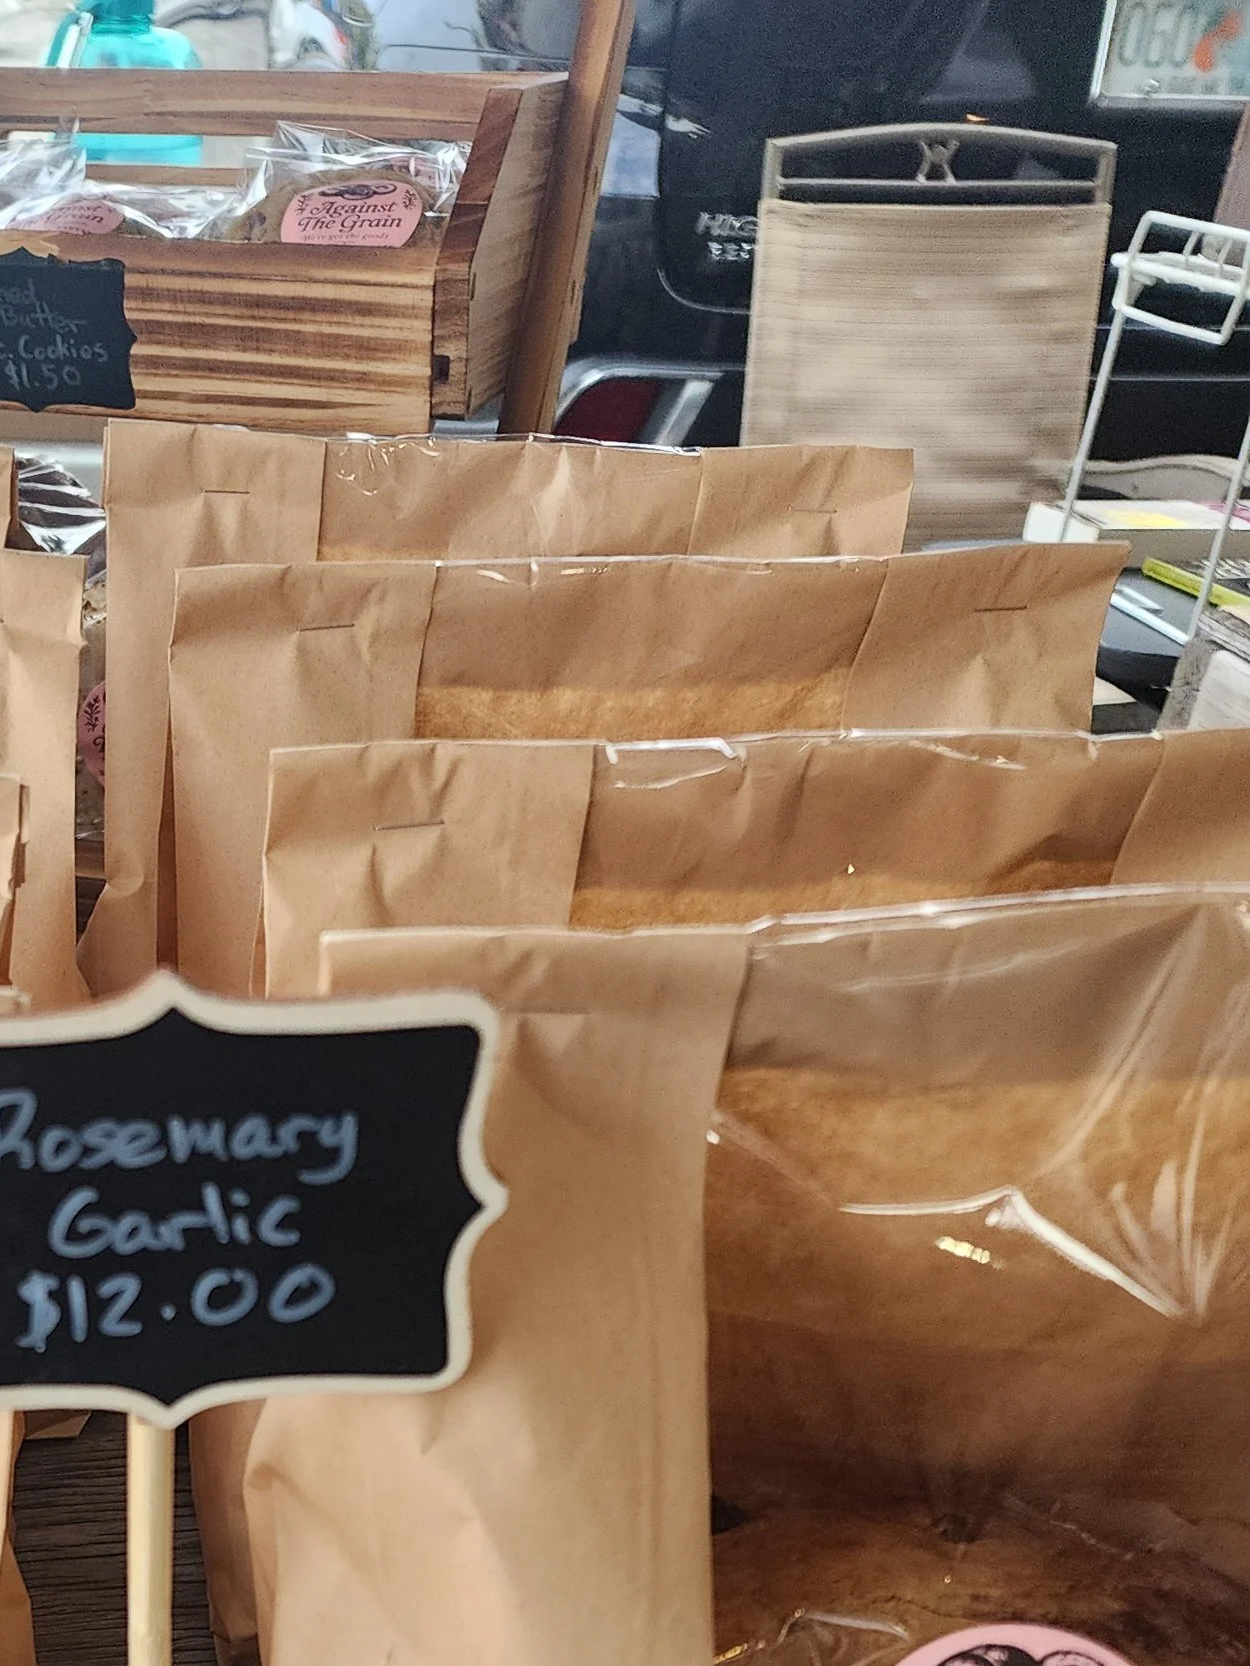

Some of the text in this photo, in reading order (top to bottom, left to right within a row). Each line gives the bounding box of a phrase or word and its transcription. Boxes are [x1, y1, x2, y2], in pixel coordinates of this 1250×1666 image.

[297, 214, 403, 233] The Grain
[310, 200, 399, 219] Against
[18, 334, 109, 362] Cookies
[4, 360, 82, 391] $1.50
[49, 1181, 302, 1259] Garlic
[16, 1261, 336, 1354] $12.00
